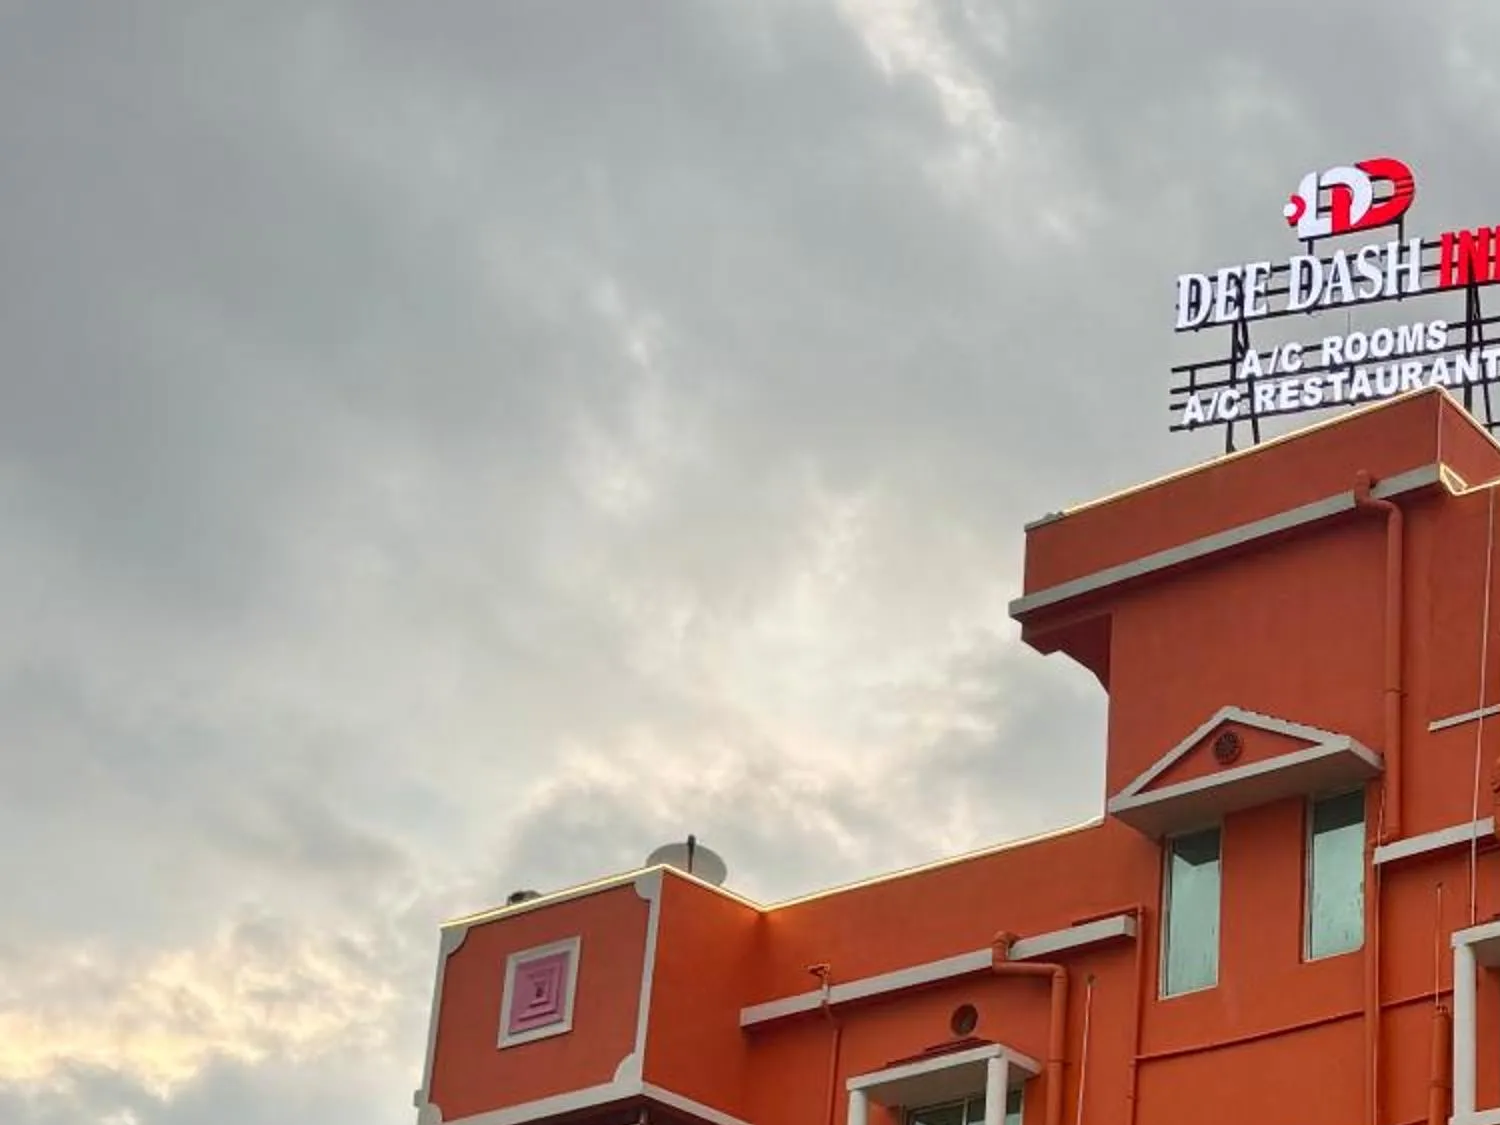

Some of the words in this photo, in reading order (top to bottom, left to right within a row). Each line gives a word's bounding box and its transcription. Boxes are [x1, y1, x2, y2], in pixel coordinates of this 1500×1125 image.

[1174, 261, 1272, 332] DEE
[1286, 237, 1425, 312] DASH
[1238, 342, 1303, 380] A/C
[1321, 318, 1449, 367] ROOMS
[1182, 388, 1241, 426] A/C
